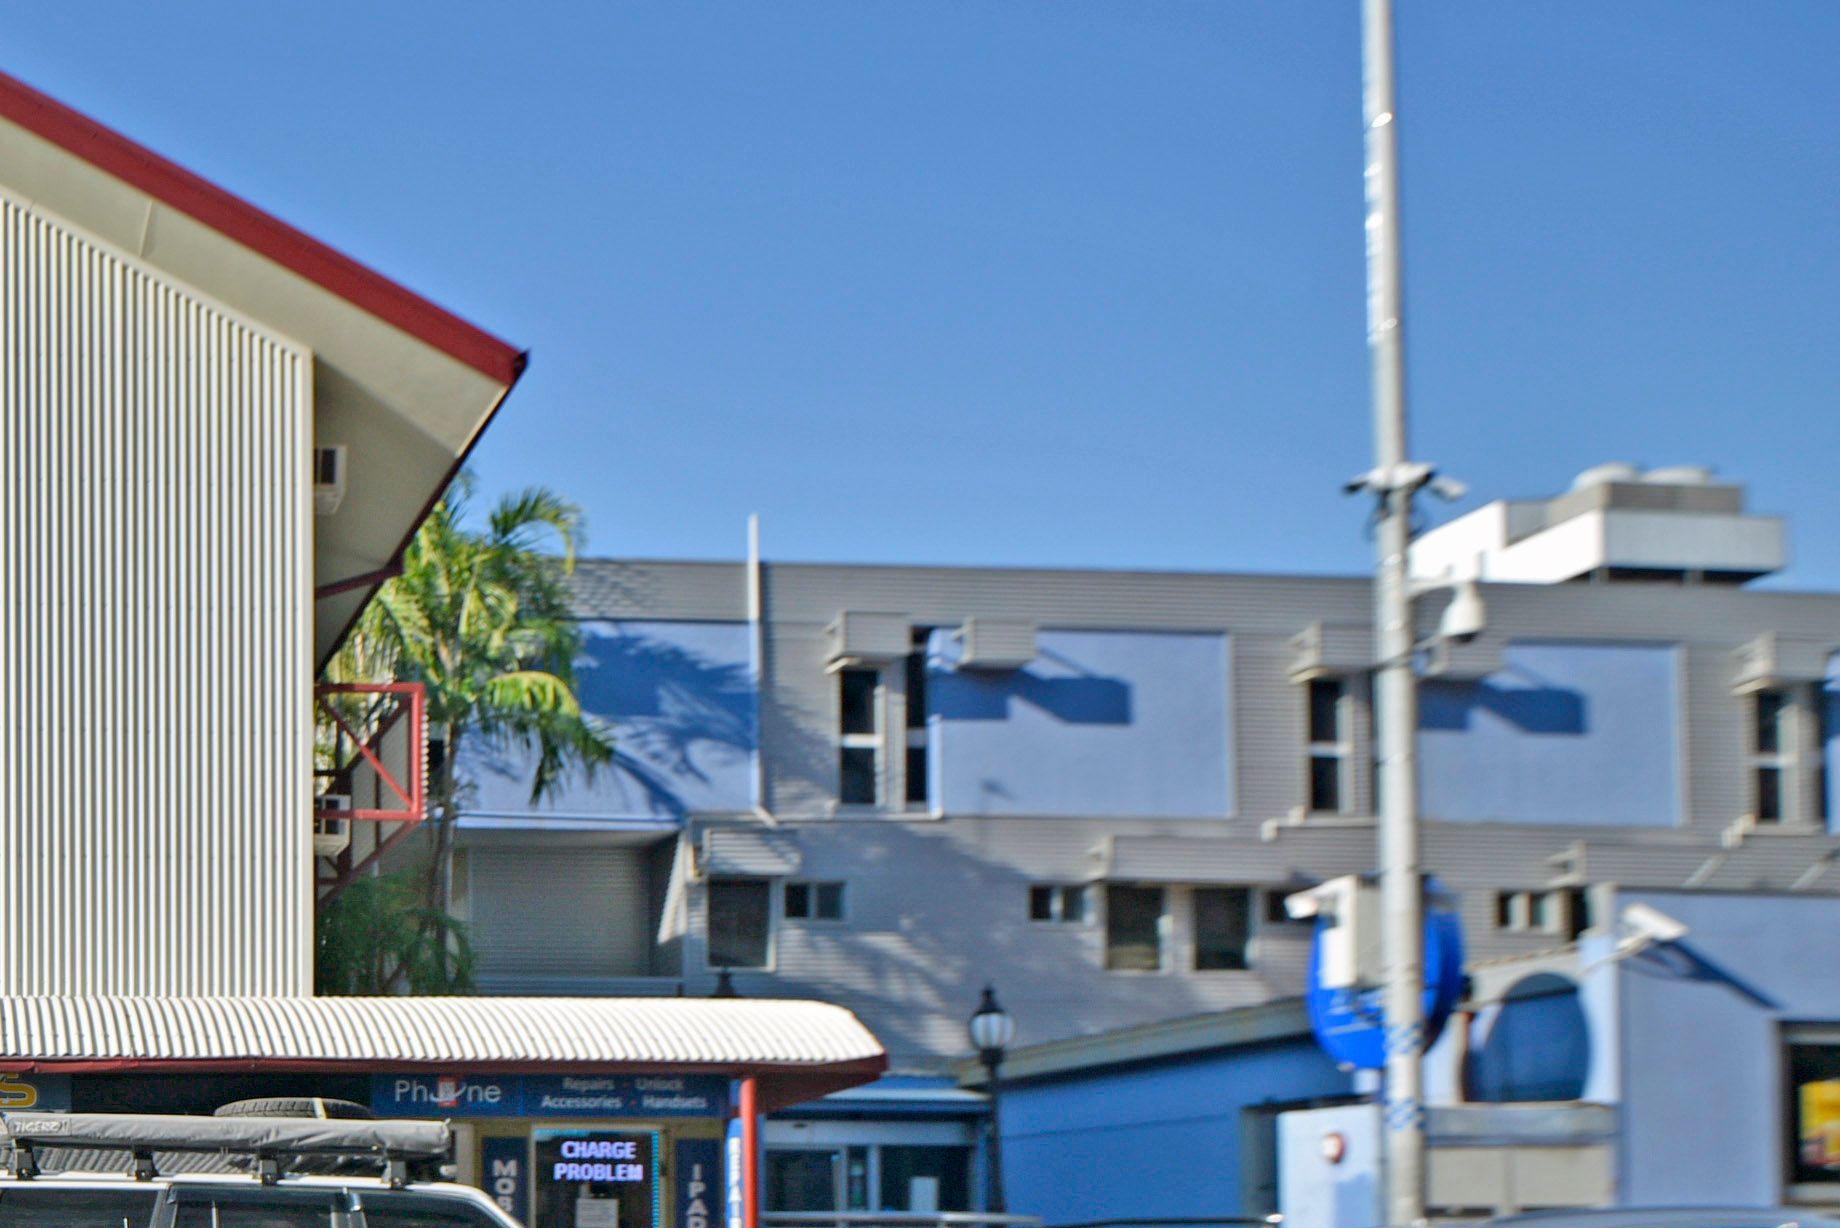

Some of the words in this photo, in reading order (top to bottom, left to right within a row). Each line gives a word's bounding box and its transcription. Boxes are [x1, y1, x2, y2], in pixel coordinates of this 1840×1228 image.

[541, 1094, 623, 1109] Accessories
[641, 1094, 709, 1109] Handsets
[561, 1141, 637, 1160] CHARGE
[553, 1162, 644, 1182] PROBLEM
